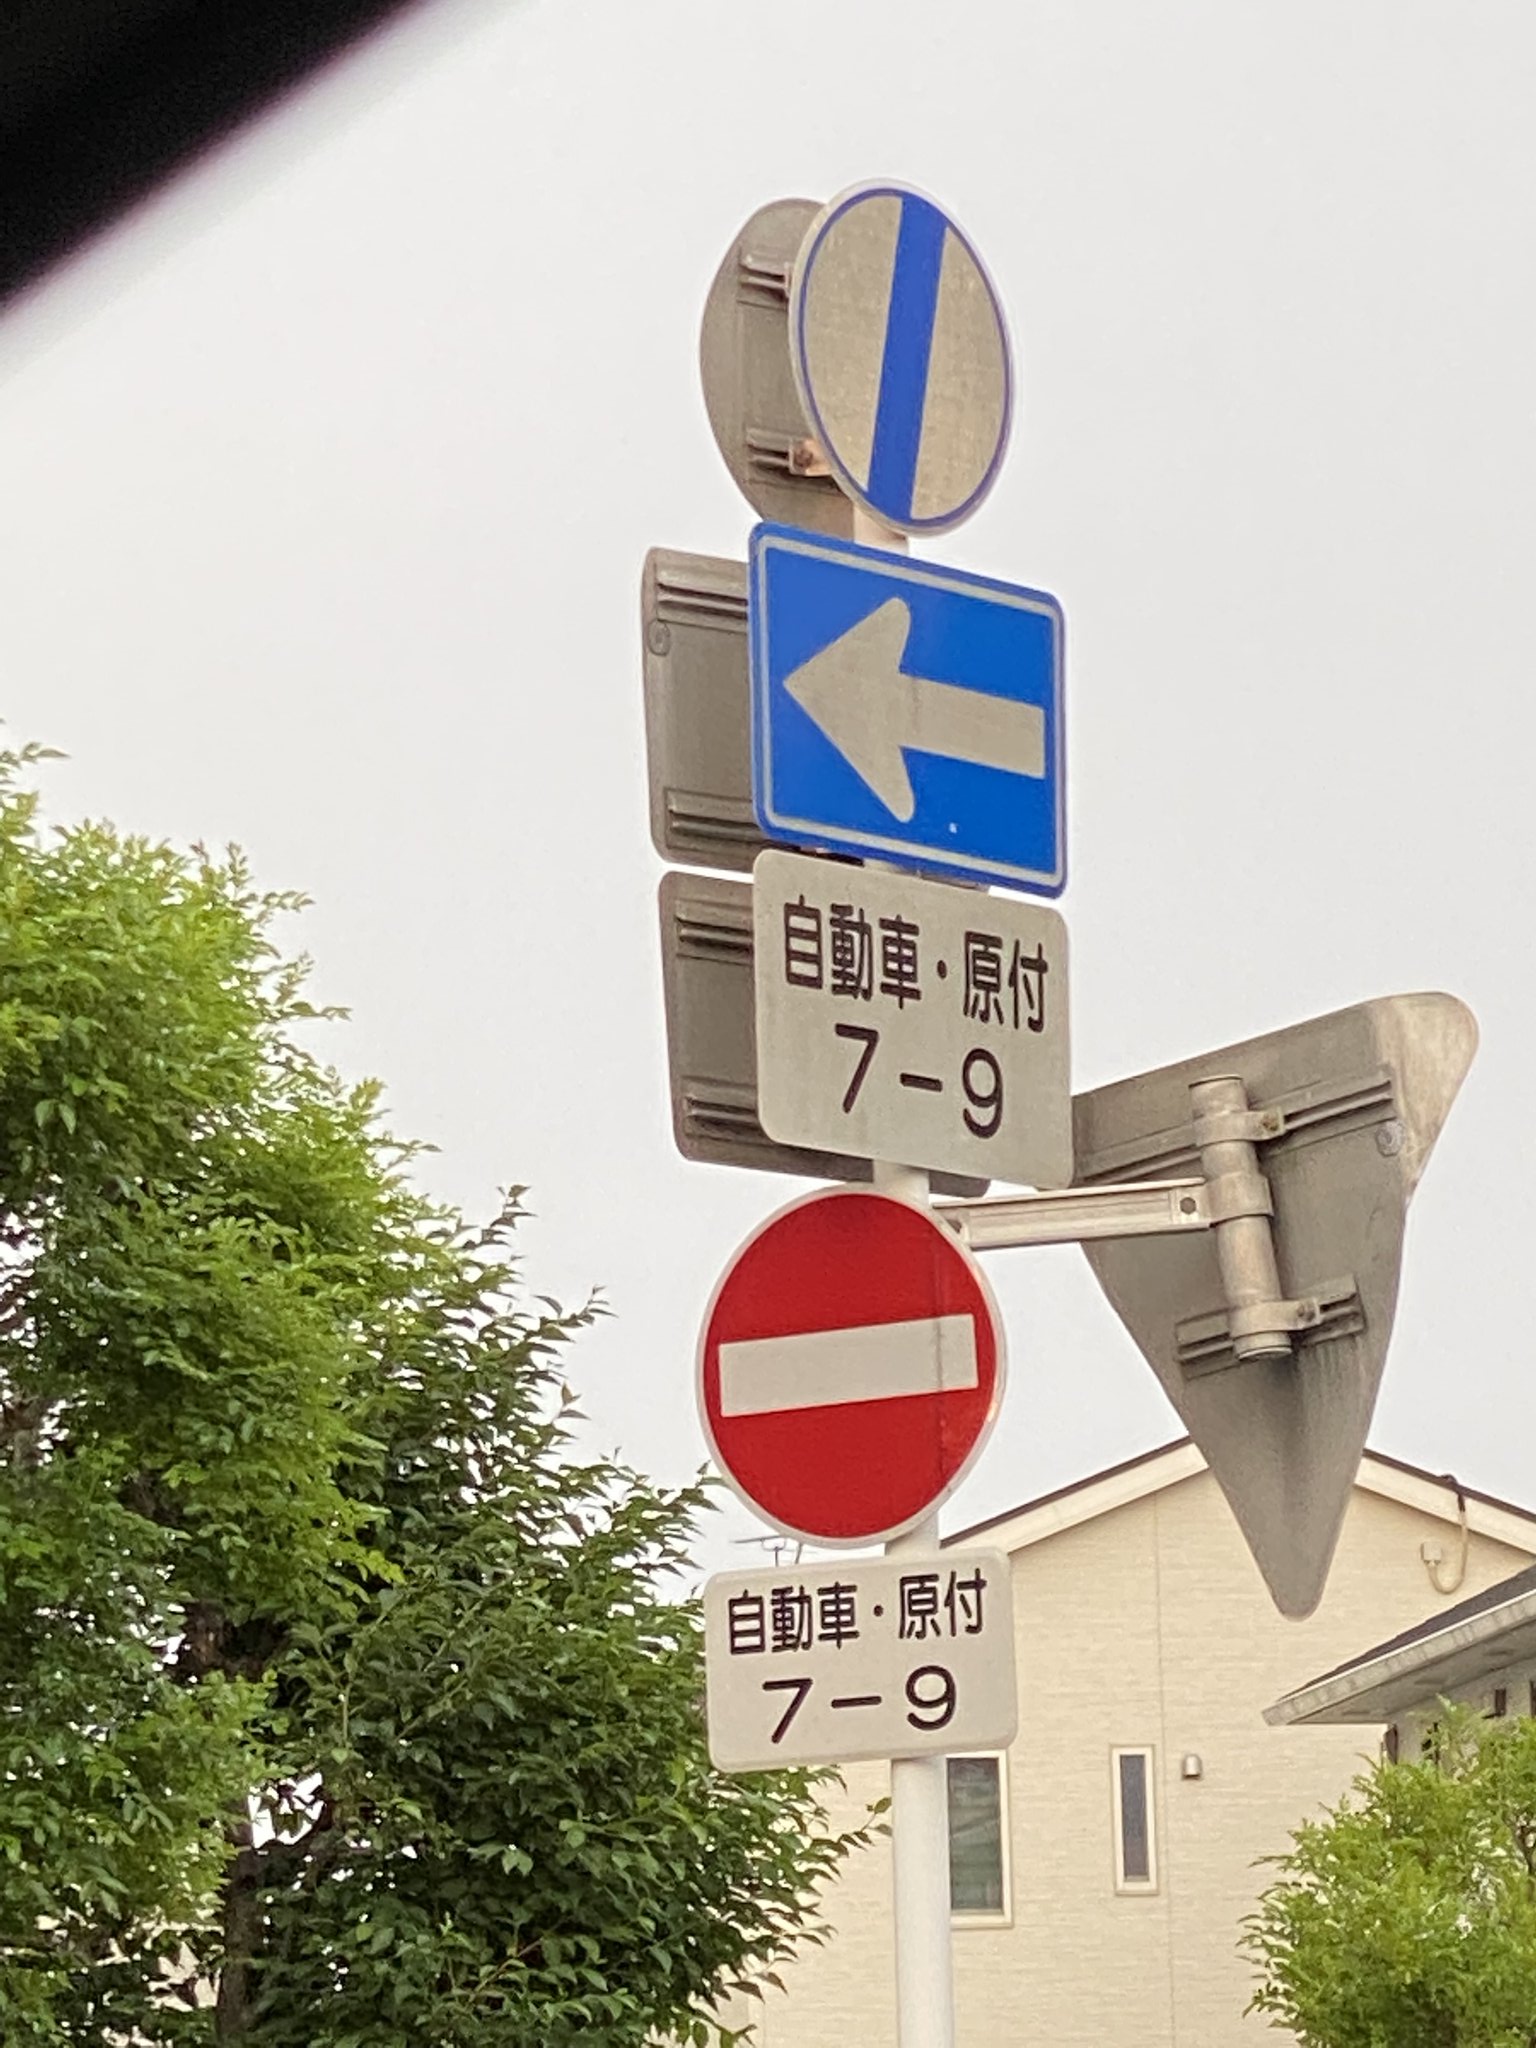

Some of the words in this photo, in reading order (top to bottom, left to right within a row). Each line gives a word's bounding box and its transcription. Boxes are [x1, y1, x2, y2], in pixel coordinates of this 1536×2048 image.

[784, 894, 1049, 1033] 自動車・原付
[728, 1567, 987, 1655] 自動車・原付
